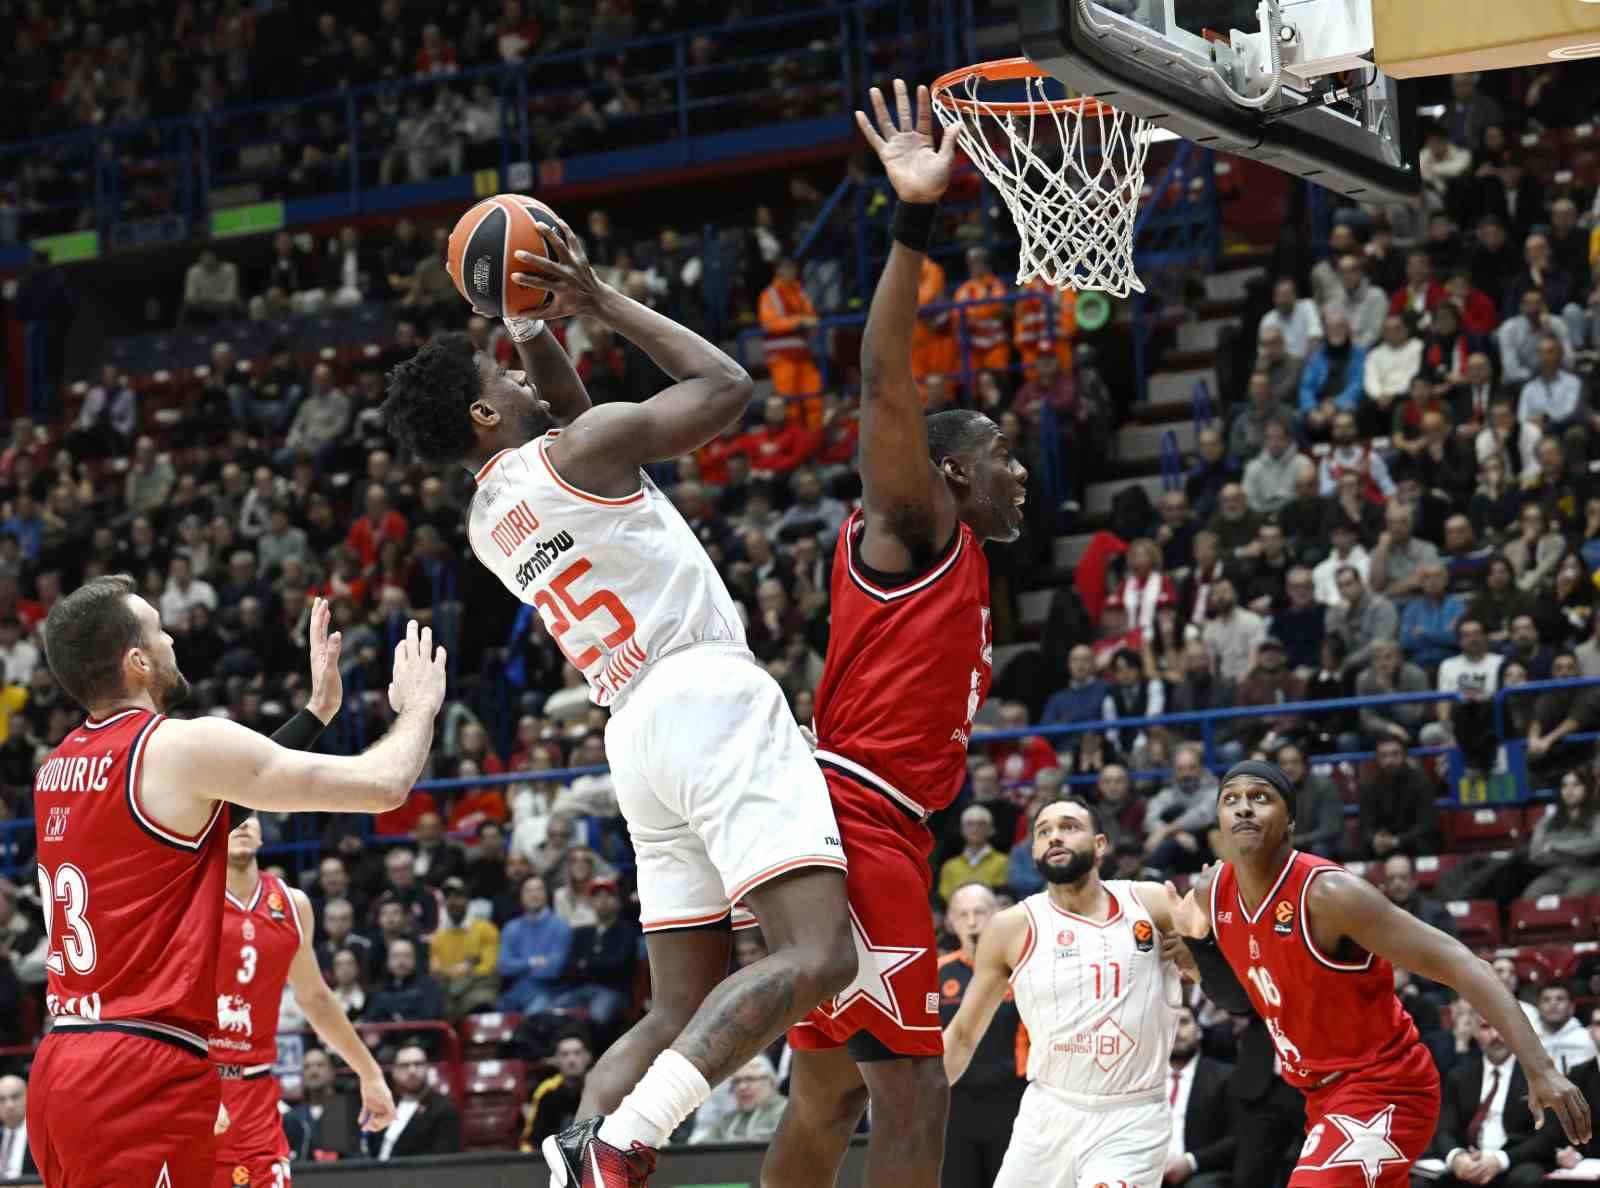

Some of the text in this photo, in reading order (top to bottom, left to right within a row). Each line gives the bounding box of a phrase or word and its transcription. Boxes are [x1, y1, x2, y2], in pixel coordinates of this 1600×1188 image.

[490, 500, 540, 557] OTURU
[534, 557, 636, 670] 25
[236, 945, 258, 985] 3
[1090, 962, 1120, 999] 11
